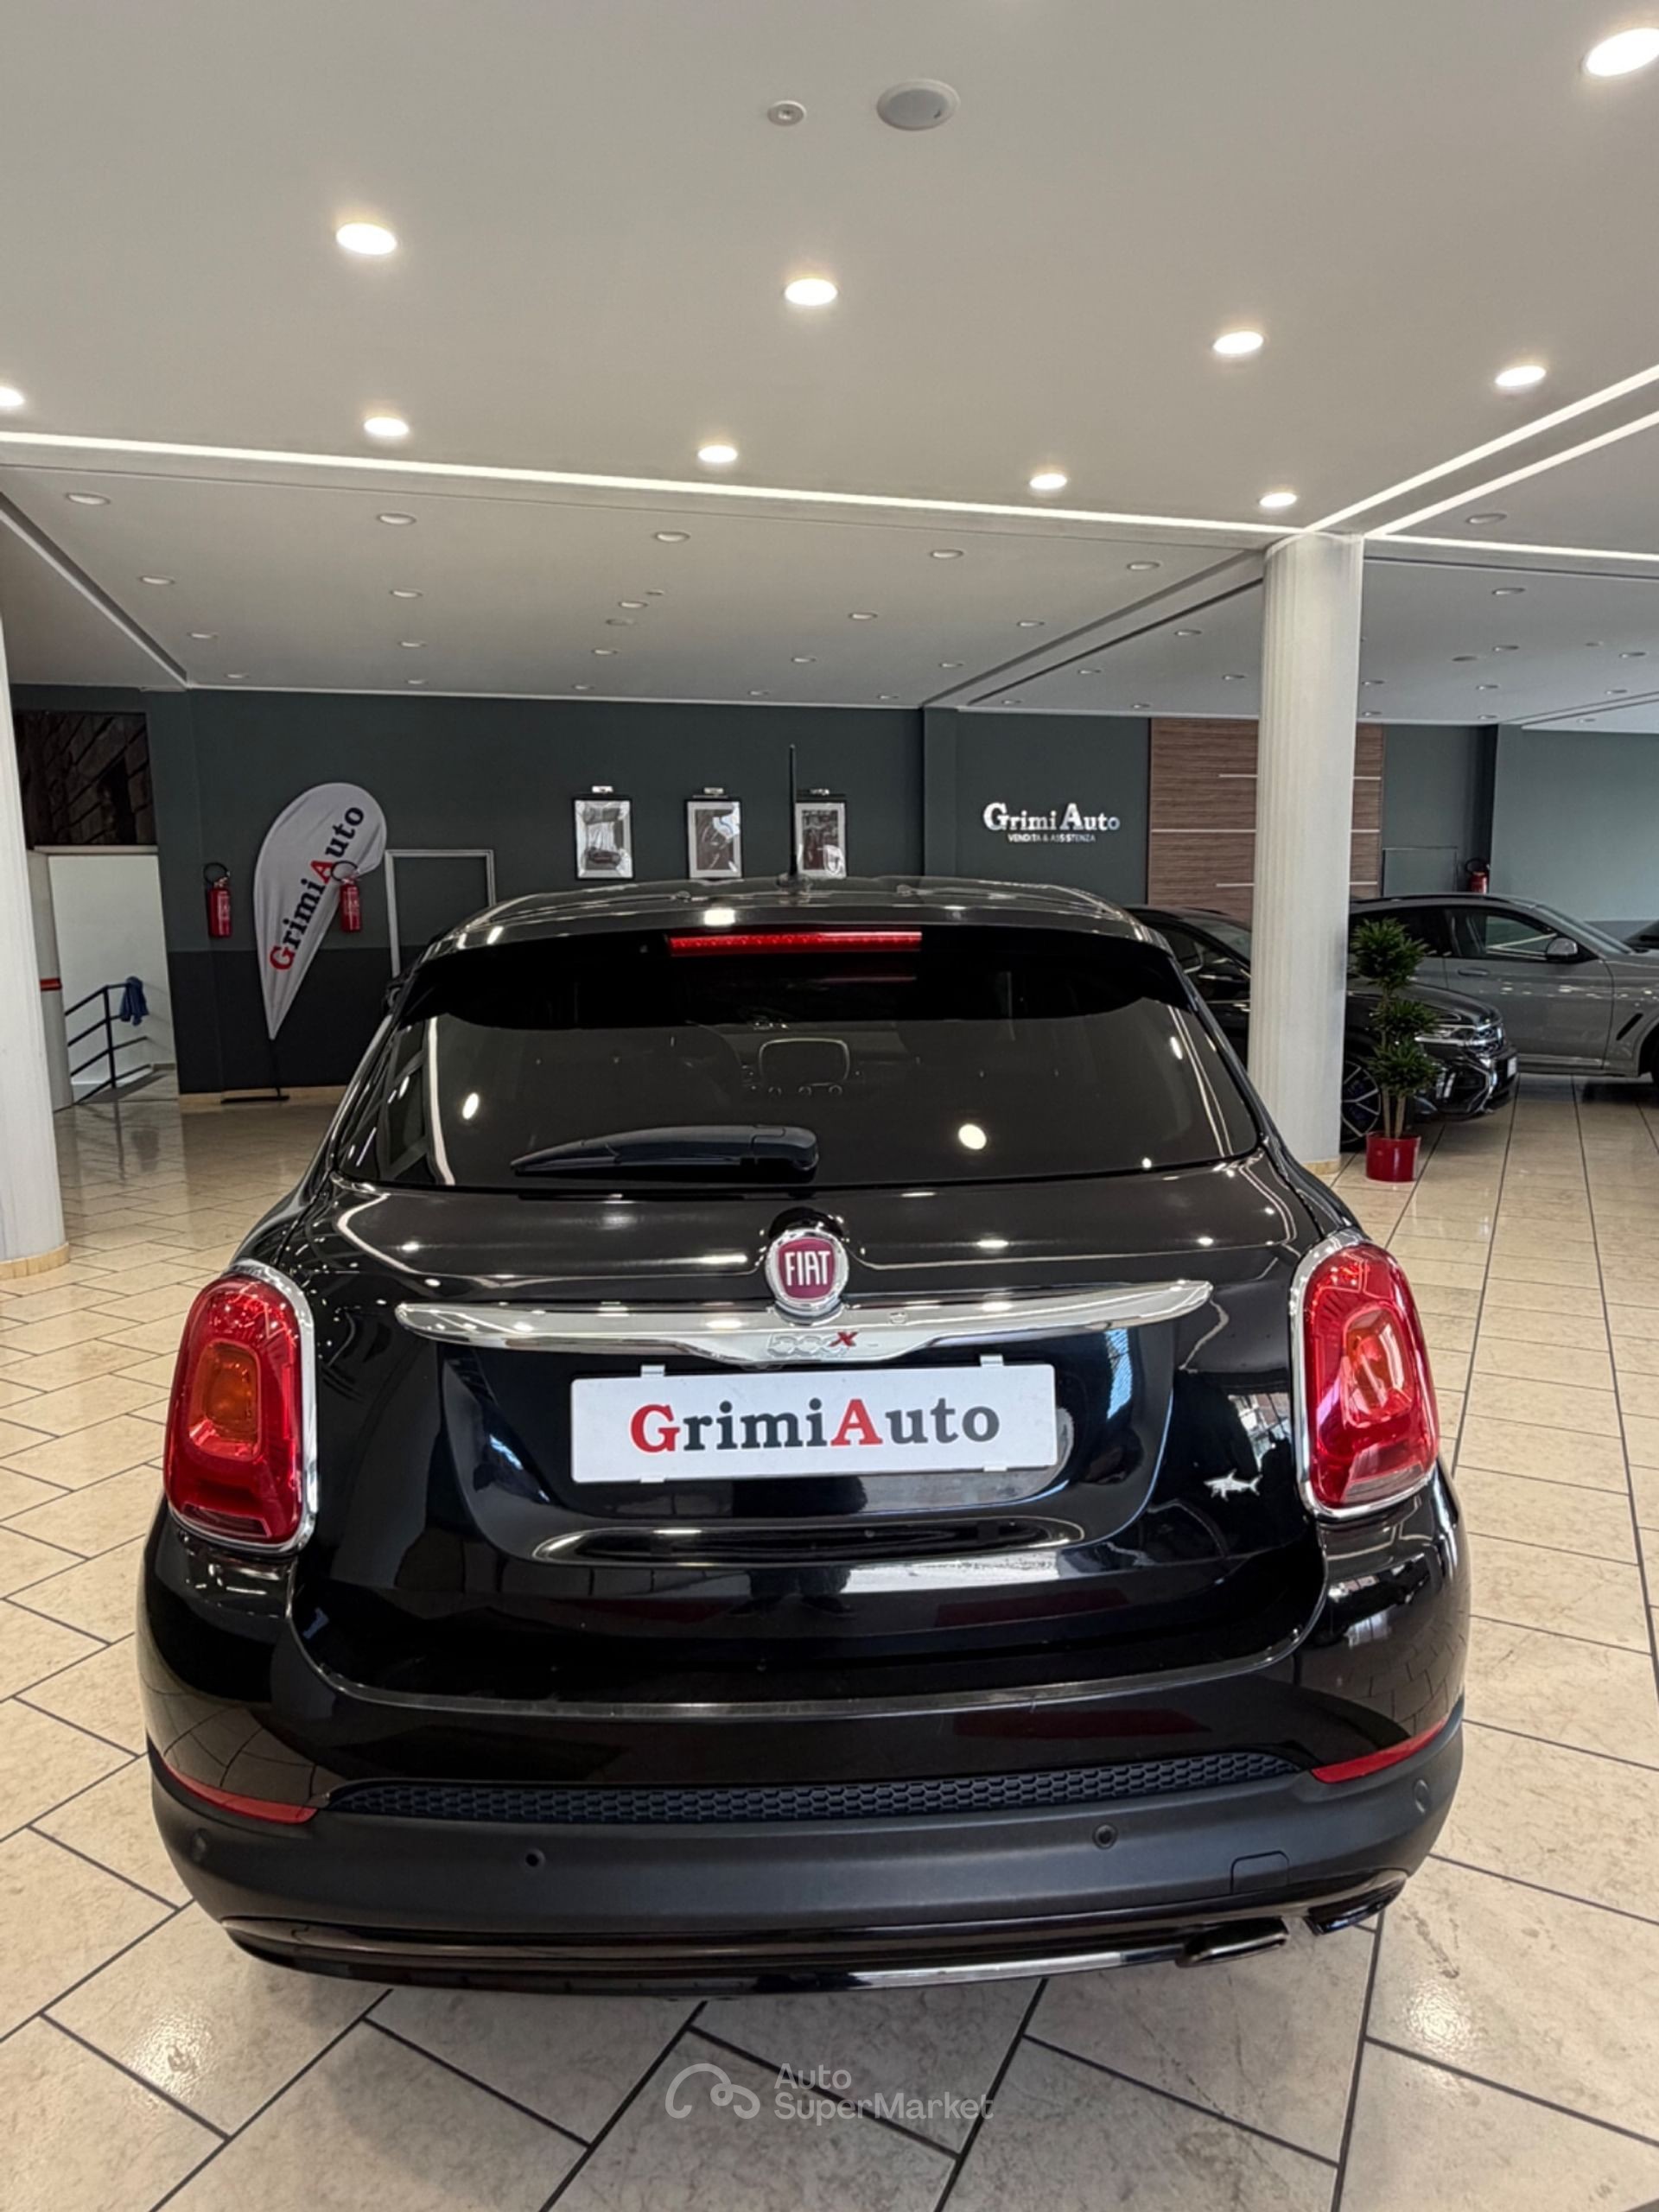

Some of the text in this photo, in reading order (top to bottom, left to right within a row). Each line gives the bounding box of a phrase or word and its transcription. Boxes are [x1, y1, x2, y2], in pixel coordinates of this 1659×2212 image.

[1007, 833, 1041, 842] VENDITA
[1051, 833, 1096, 842] ASSISTENZA
[270, 807, 364, 970] GrimiAuto
[785, 1251, 830, 1286] FIAT
[630, 1397, 1000, 1452] GrimiAuto
